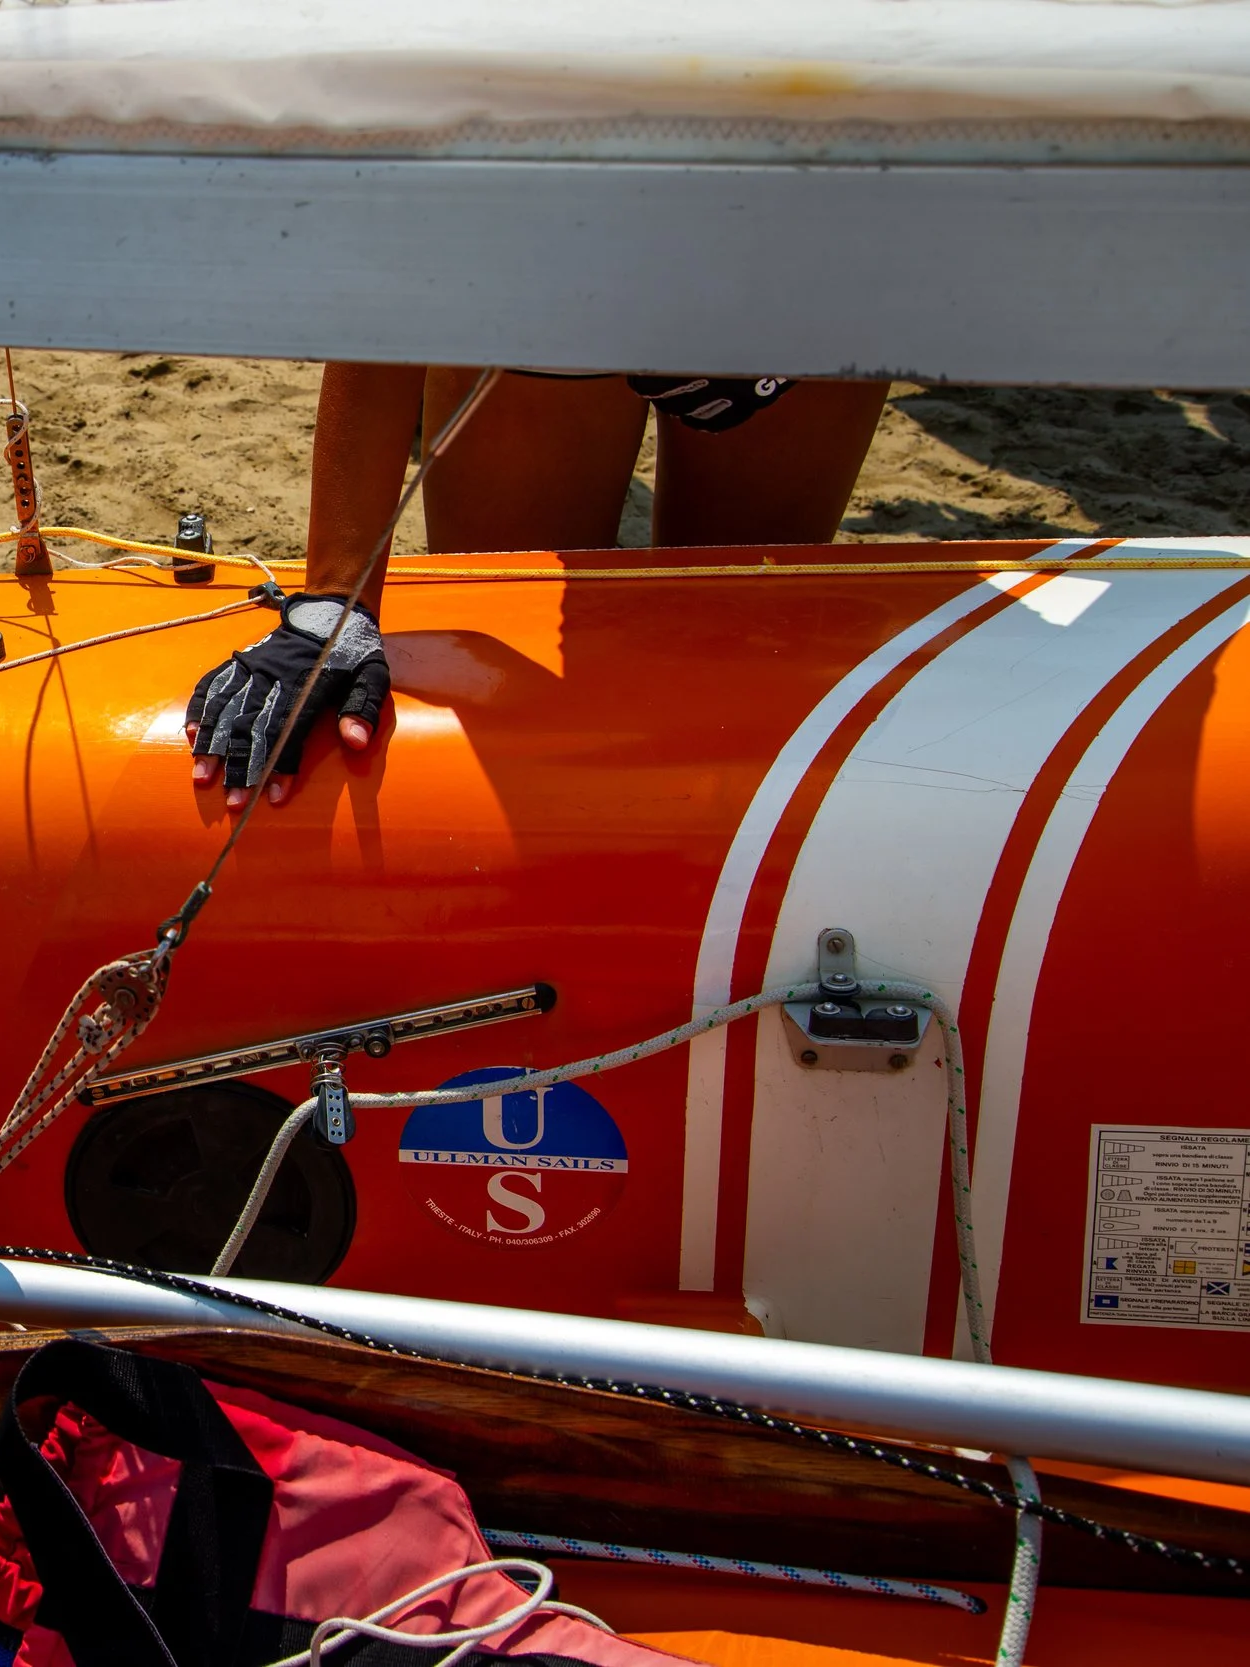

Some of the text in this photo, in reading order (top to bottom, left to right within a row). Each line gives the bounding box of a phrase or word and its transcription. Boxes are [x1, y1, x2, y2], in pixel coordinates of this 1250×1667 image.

[483, 1087, 553, 1150] U
[1160, 1134, 1198, 1142] SEGNALI
[413, 1151, 615, 1171] ULLMAN SAILS
[425, 1197, 455, 1226] TRIESTE
[458, 1224, 482, 1240] ITALY
[489, 1235, 504, 1245] PH.
[558, 1225, 579, 1239] FAX.
[486, 1170, 546, 1234] S
